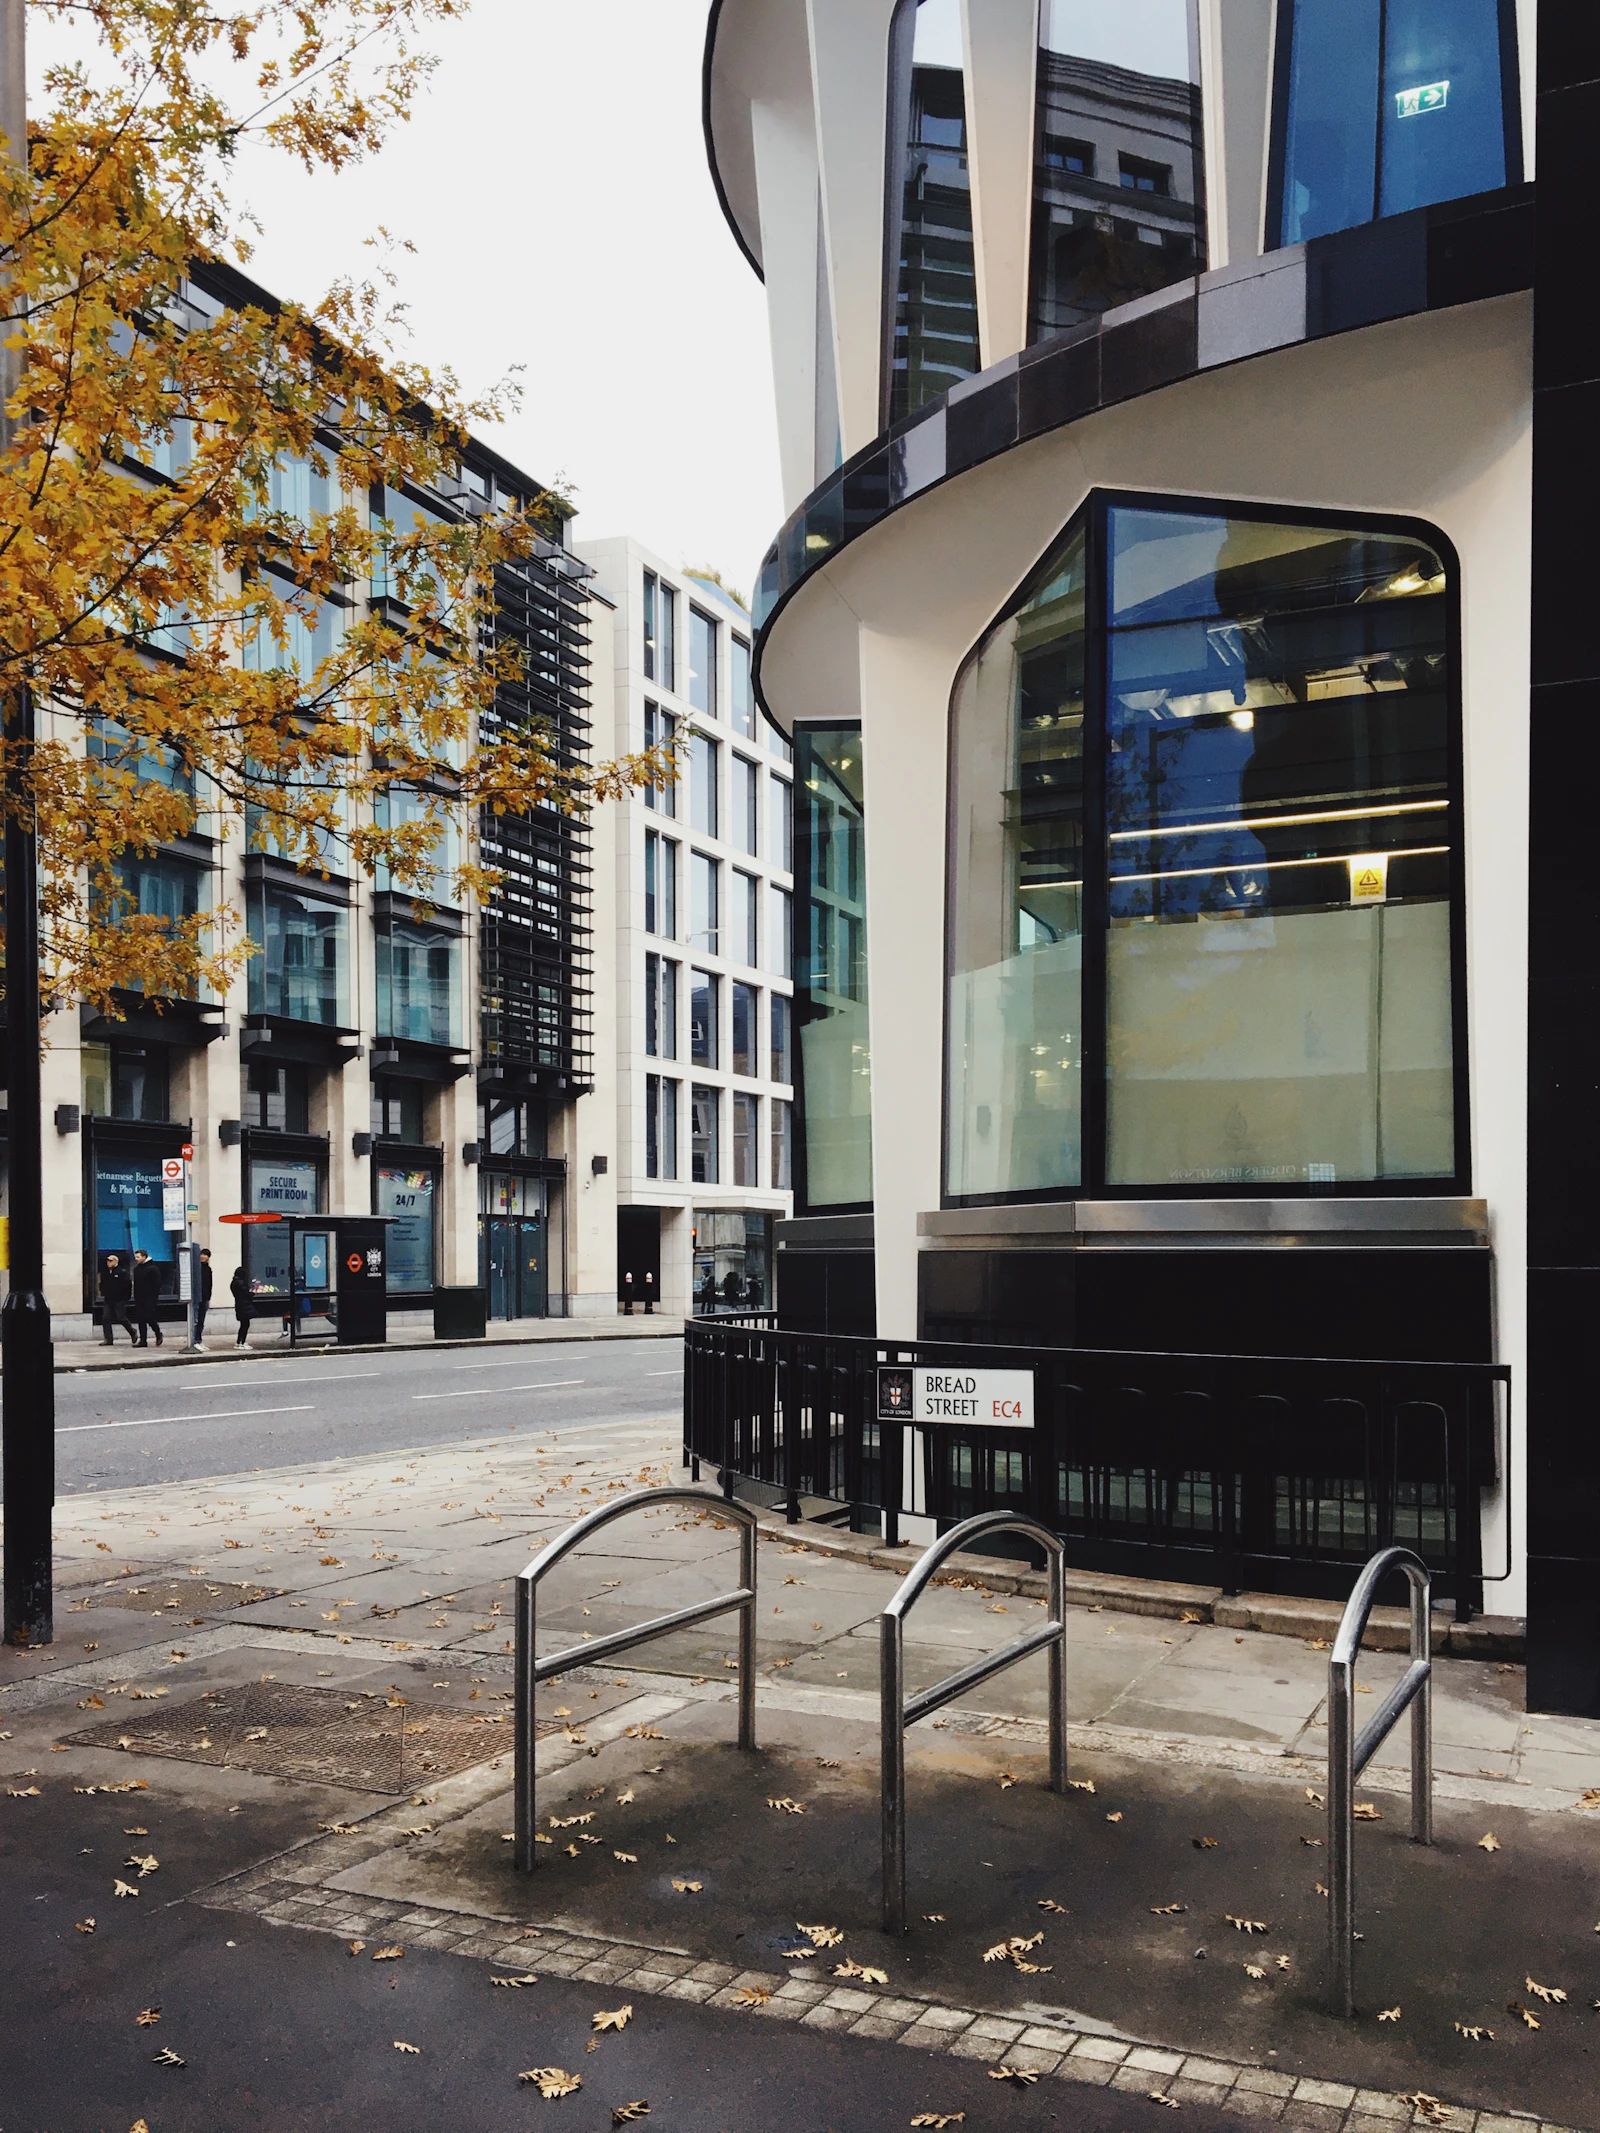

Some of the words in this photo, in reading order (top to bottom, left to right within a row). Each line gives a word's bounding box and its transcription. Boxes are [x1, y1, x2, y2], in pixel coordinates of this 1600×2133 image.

[96, 1170, 134, 1181] ietnamese
[135, 1172, 162, 1184] Baguett
[269, 1176, 298, 1188] SECURE
[110, 1184, 117, 1194] &
[119, 1184, 133, 1195] Pho
[260, 1188, 284, 1200] PRINT
[284, 1189, 308, 1200] ROOM
[395, 1194, 416, 1207] 24/7
[265, 1266, 278, 1278] UK
[926, 1376, 976, 1393] BREAD
[926, 1398, 979, 1416] STREET
[992, 1400, 1022, 1418] EC4
